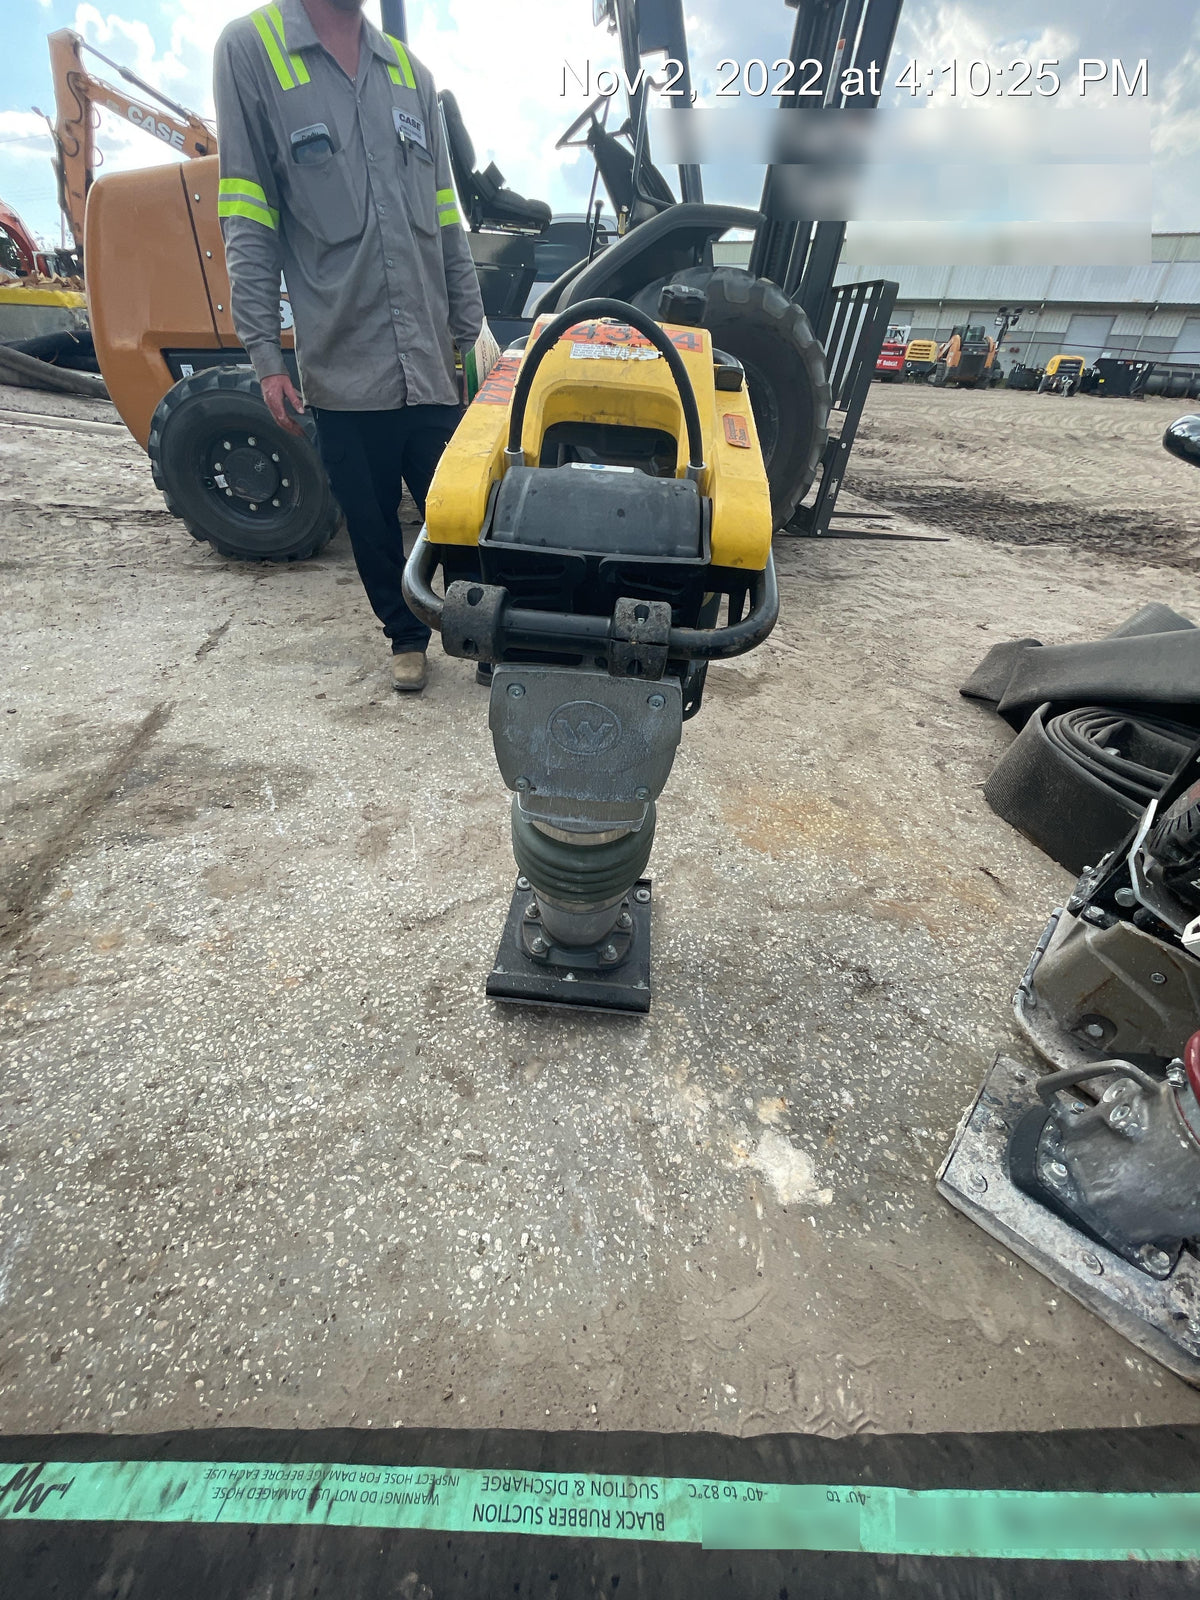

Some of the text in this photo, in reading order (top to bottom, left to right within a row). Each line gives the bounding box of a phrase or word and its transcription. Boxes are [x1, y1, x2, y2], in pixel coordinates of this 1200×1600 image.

[127, 105, 186, 150] CASE
[399, 113, 422, 131] CASE
[229, 1469, 260, 1480] EACH
[261, 1469, 305, 1481] BEFORE
[307, 1469, 357, 1482] DAMAGE
[358, 1471, 382, 1483] FOR
[384, 1472, 413, 1484] HOSE
[415, 1473, 460, 1487] INSPECT
[481, 1475, 659, 1499] SUCTION & DISCHARGE
[687, 1483, 768, 1502] -40° to 82°C
[211, 1486, 439, 1506] WARNING! DO NOT US DAMAGED HOSE.
[826, 1490, 840, 1503] to
[472, 1503, 665, 1531] BLACK RUBBER SUCTION
